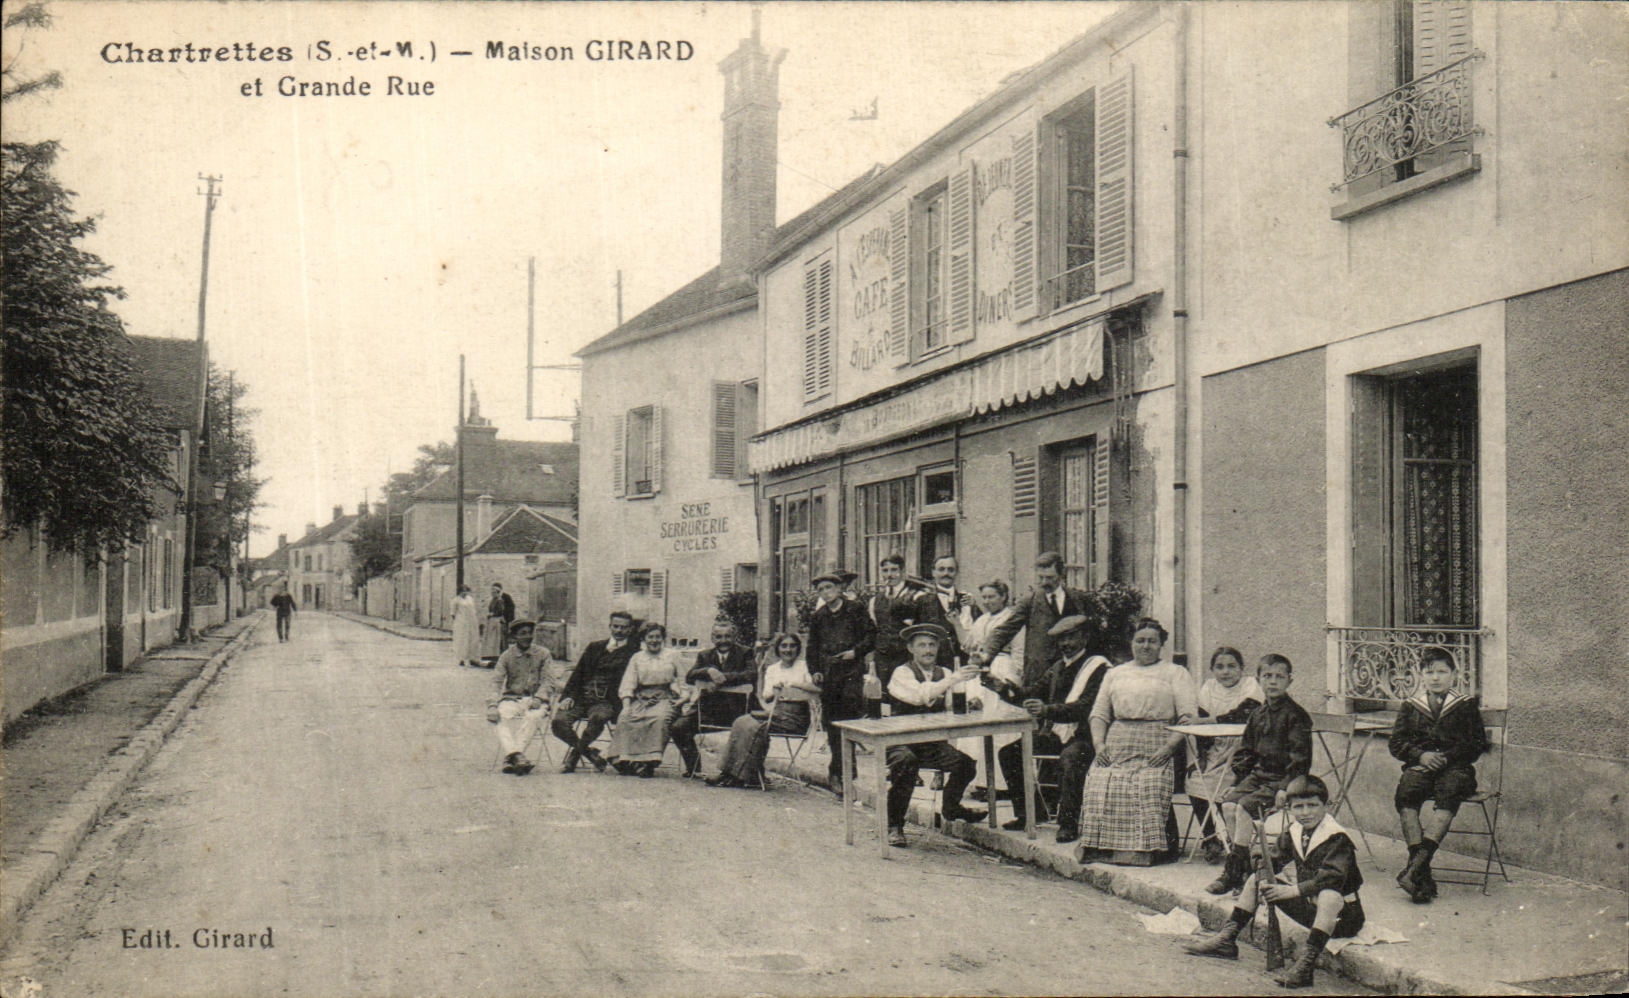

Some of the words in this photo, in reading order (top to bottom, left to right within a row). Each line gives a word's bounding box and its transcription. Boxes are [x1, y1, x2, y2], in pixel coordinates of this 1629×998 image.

[854, 276, 889, 320] CAFE
[681, 502, 711, 520] SENE
[660, 516, 729, 539] SERRURERIE
[673, 536, 717, 552] CYCLES
